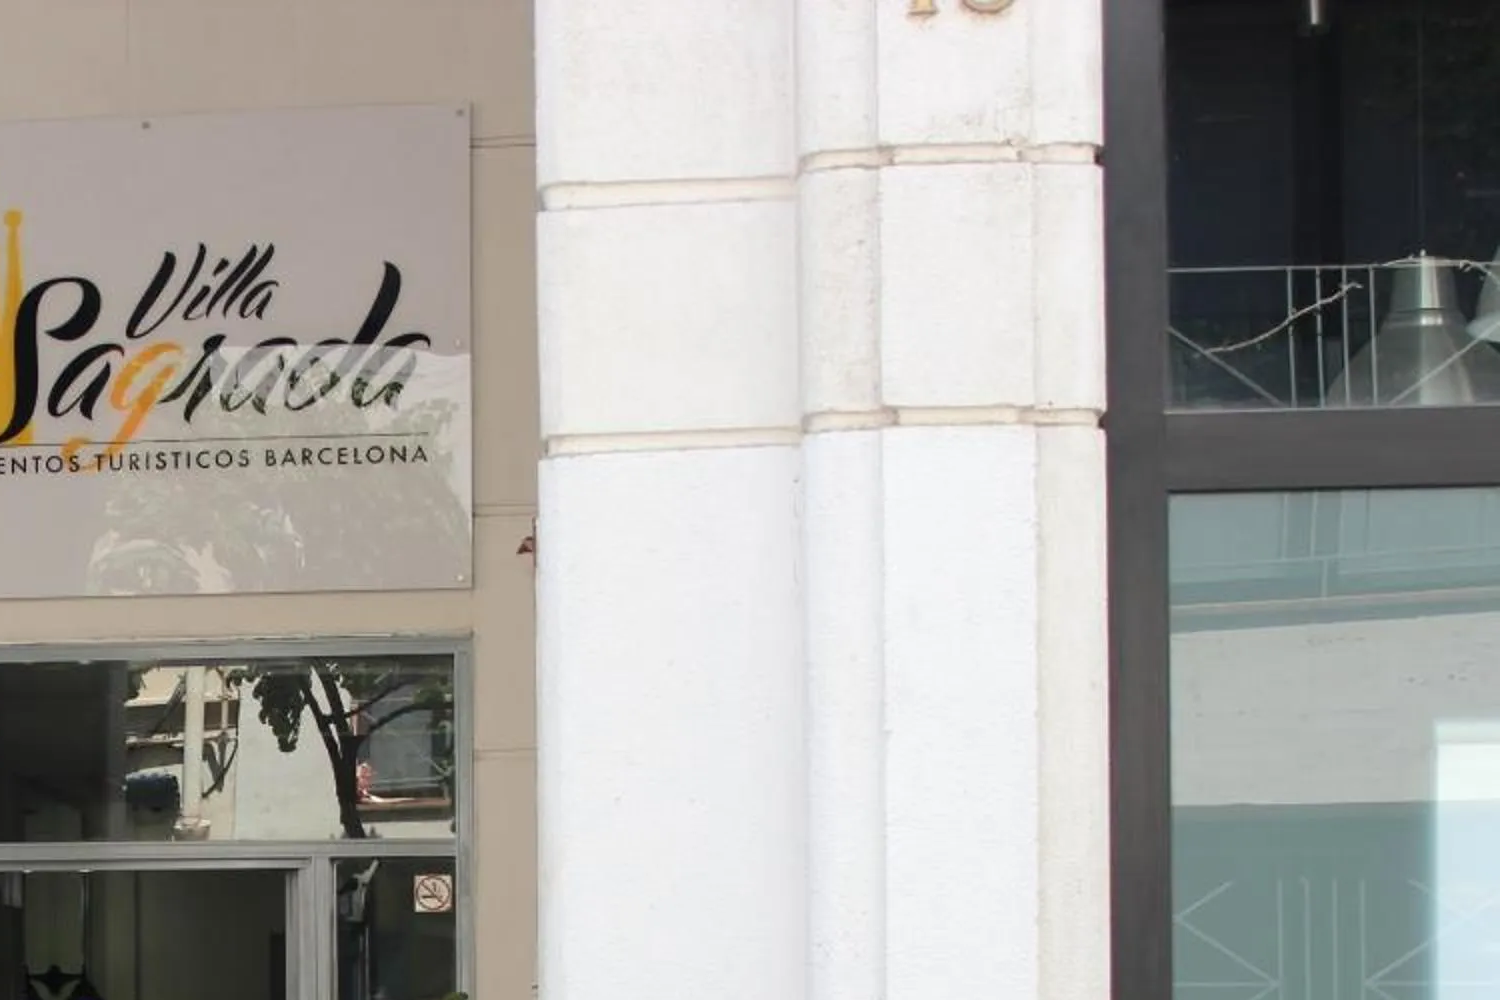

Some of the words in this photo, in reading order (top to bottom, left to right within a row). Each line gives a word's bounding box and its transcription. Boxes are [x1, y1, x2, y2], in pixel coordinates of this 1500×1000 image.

[126, 243, 280, 339] Villa
[94, 449, 251, 473] TURISTICOS
[265, 444, 428, 468] BARCELONA
